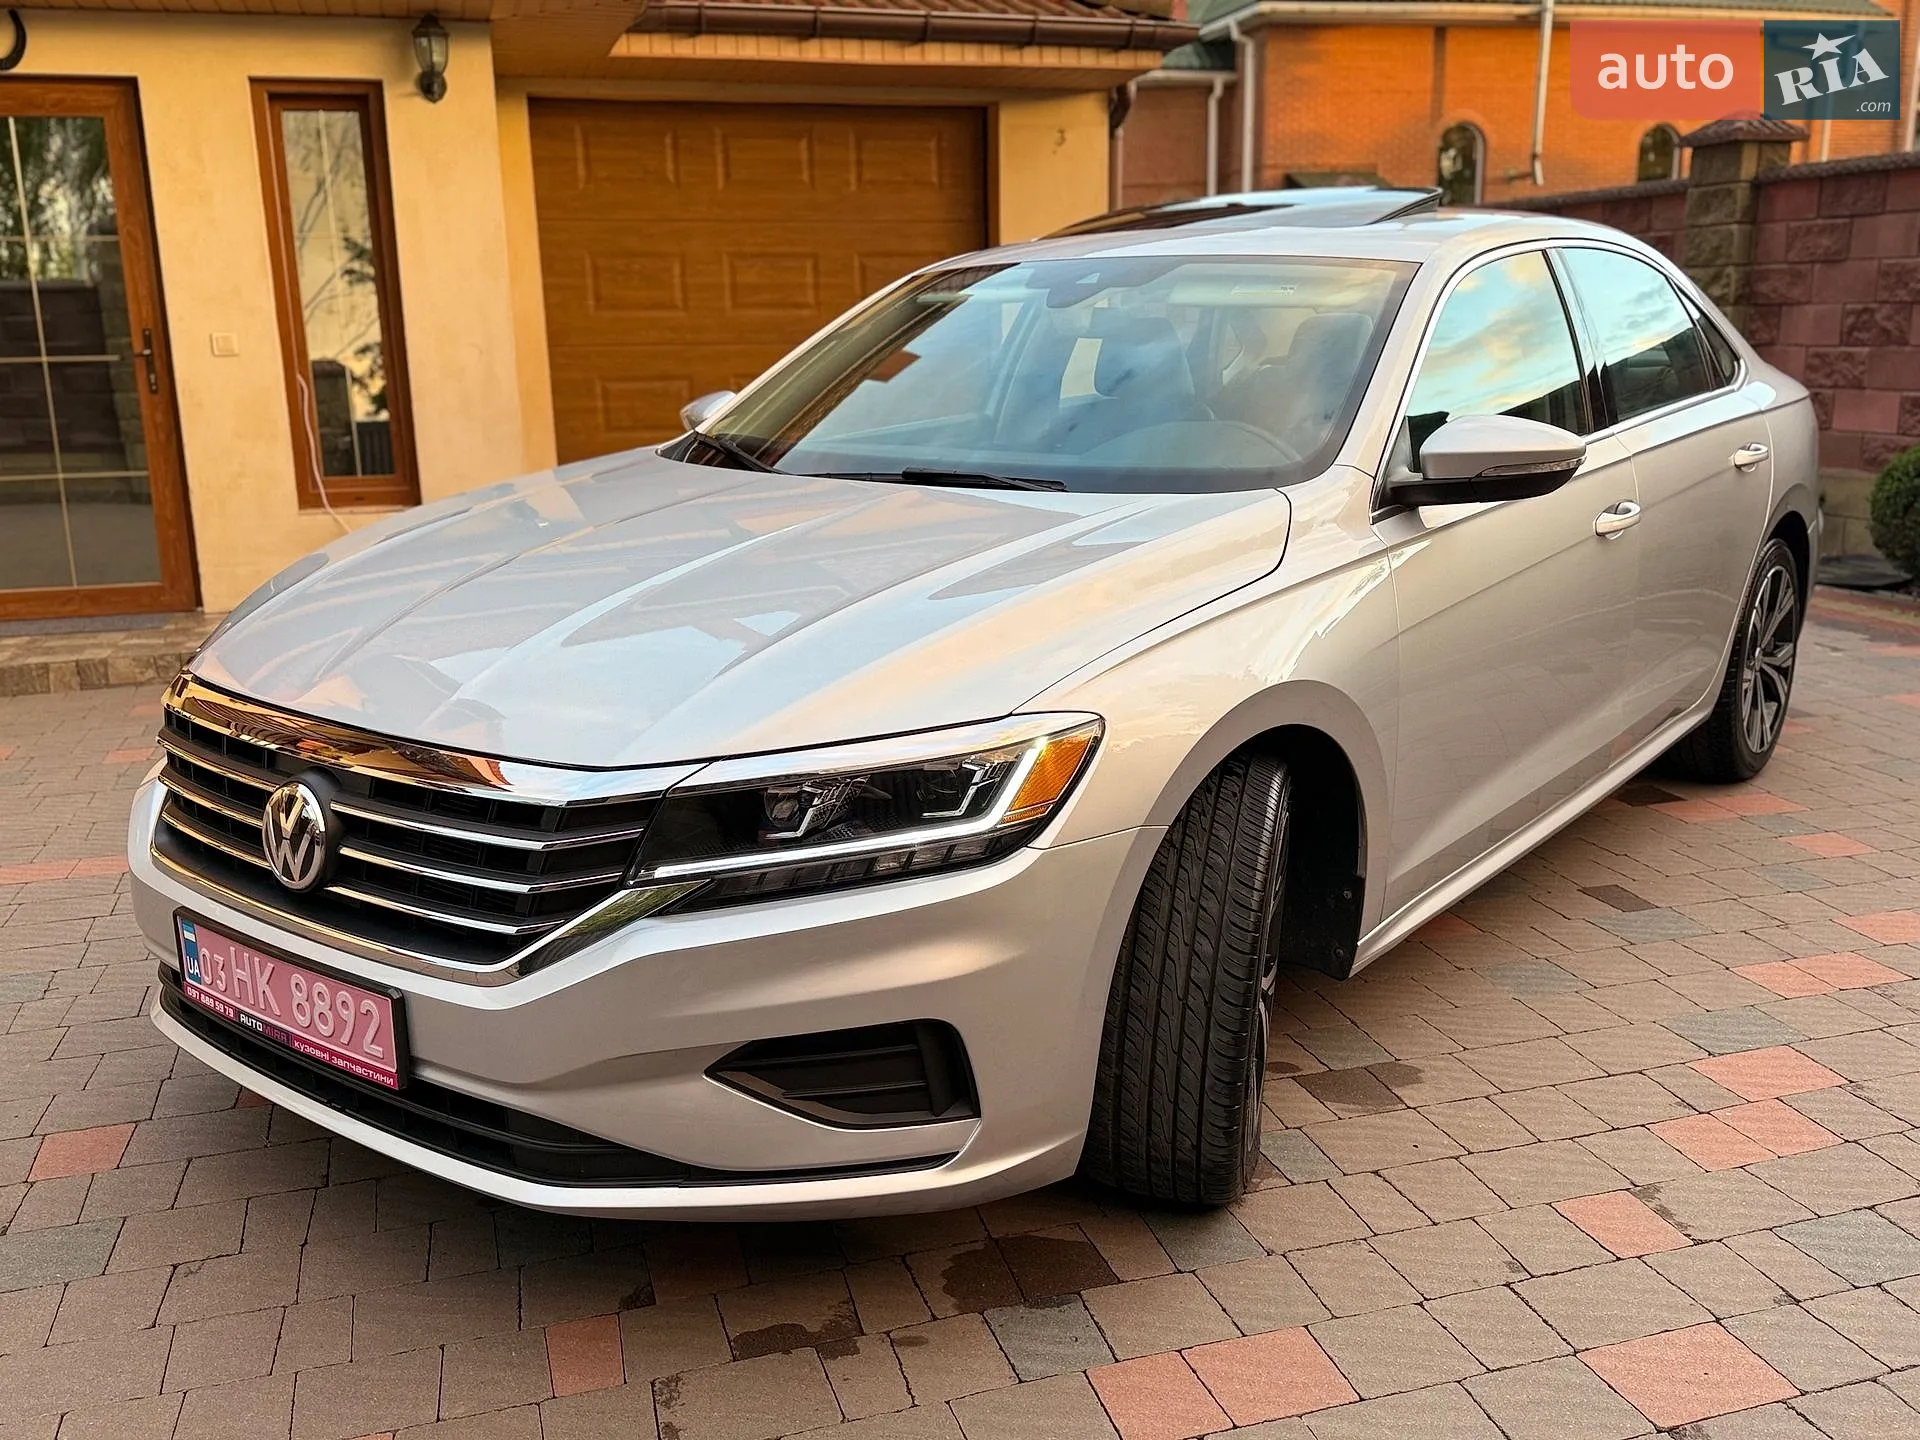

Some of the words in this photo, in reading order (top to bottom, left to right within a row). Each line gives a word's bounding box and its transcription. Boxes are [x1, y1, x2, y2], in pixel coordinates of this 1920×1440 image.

[187, 957, 201, 977] UA
[290, 973, 384, 1060] 8892
[294, 1040, 329, 1061] кузовні
[332, 1055, 394, 1086] запчастини
